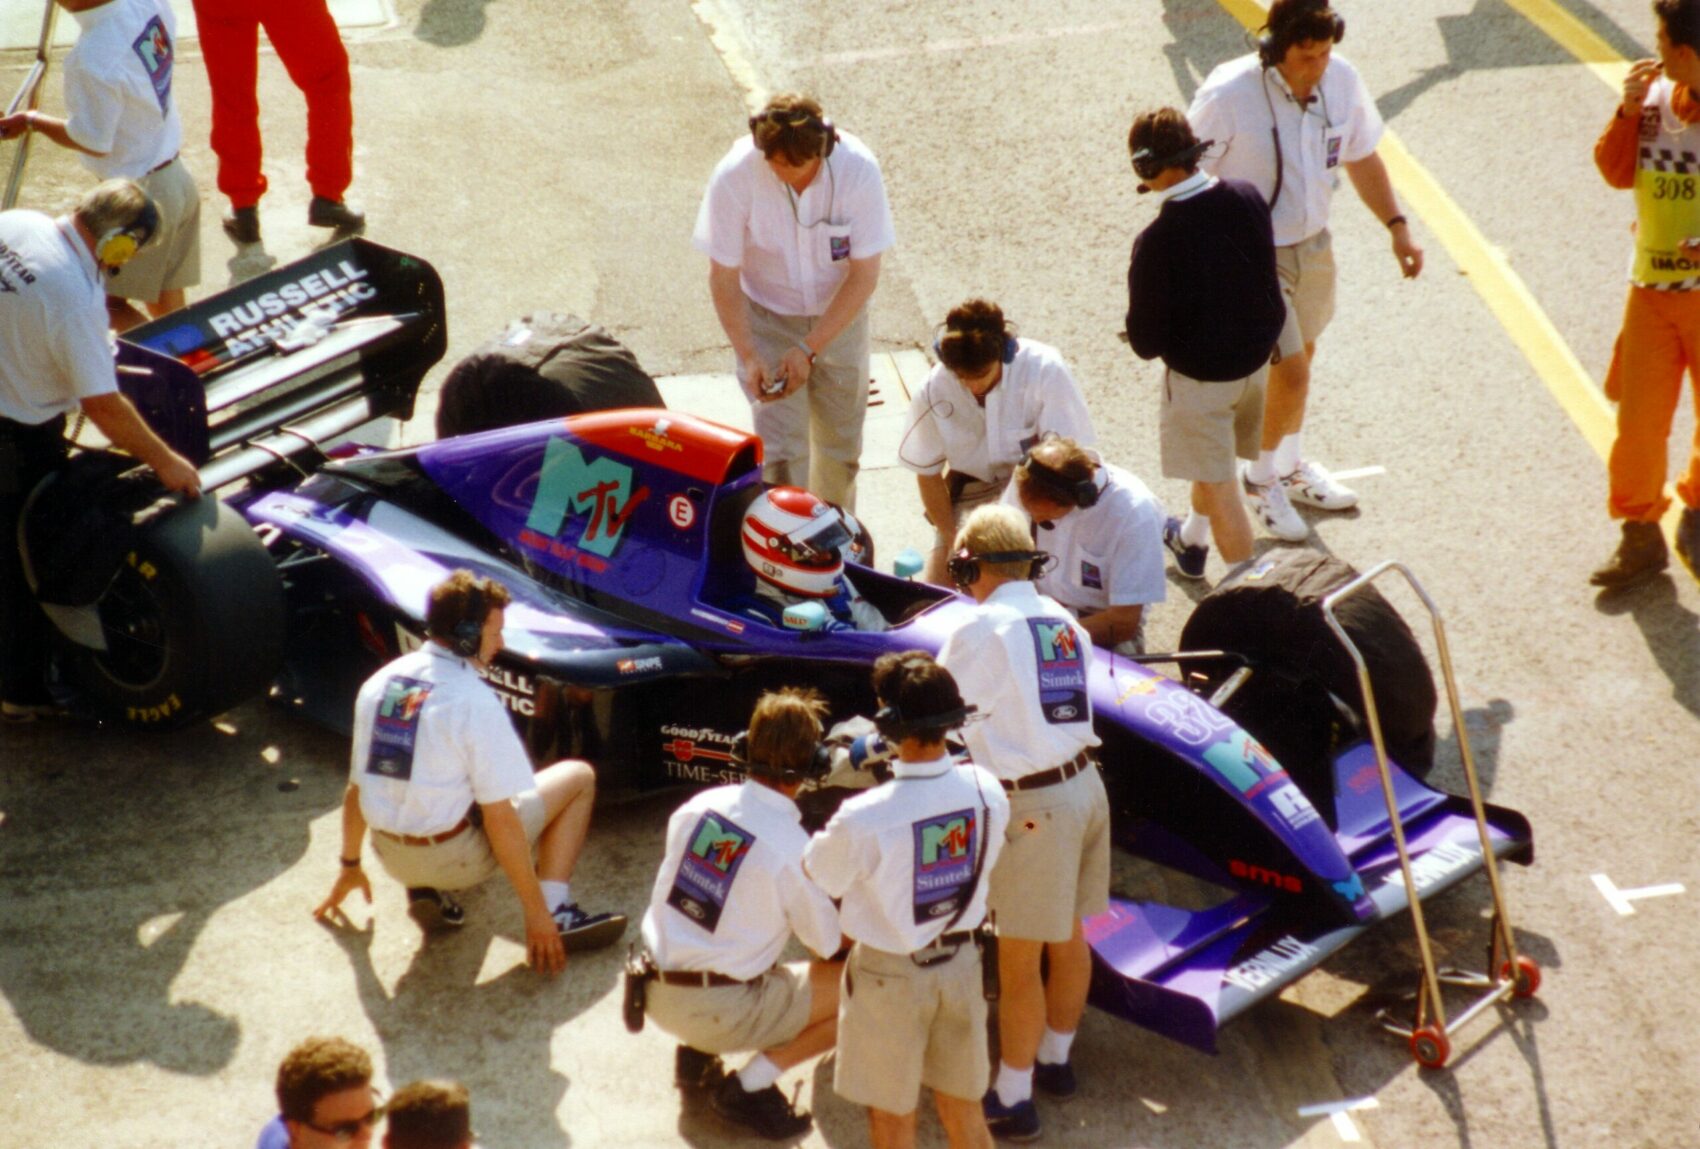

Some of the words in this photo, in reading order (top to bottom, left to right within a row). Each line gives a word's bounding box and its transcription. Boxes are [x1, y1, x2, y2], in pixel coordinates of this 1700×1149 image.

[1653, 177, 1697, 201] 308
[208, 260, 368, 338] RUSSELL
[525, 433, 651, 558] MTV
[1035, 622, 1078, 661] MTV
[1040, 669, 1083, 688] Simtek
[1145, 689, 1237, 745] 32
[691, 817, 750, 873] MTV
[921, 817, 976, 865] MTV
[680, 860, 725, 901] Simtek
[917, 863, 972, 891] Simtek
